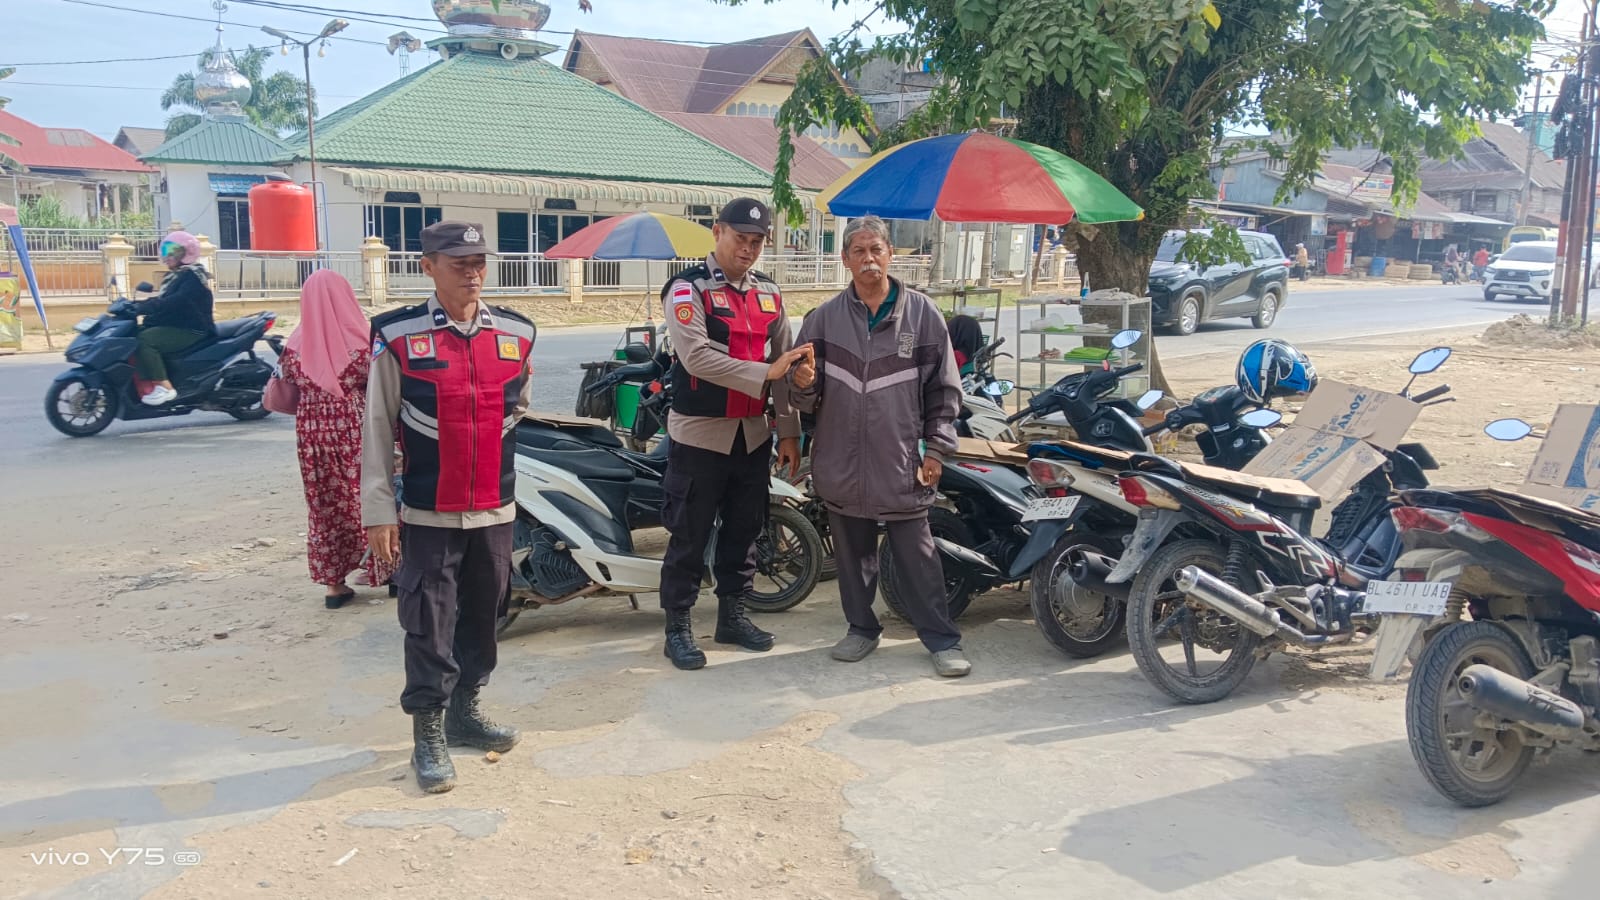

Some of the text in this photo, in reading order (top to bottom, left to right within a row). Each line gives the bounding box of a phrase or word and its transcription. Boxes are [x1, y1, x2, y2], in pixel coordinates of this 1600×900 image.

[1367, 582, 1450, 598] BL 4611 UAB
